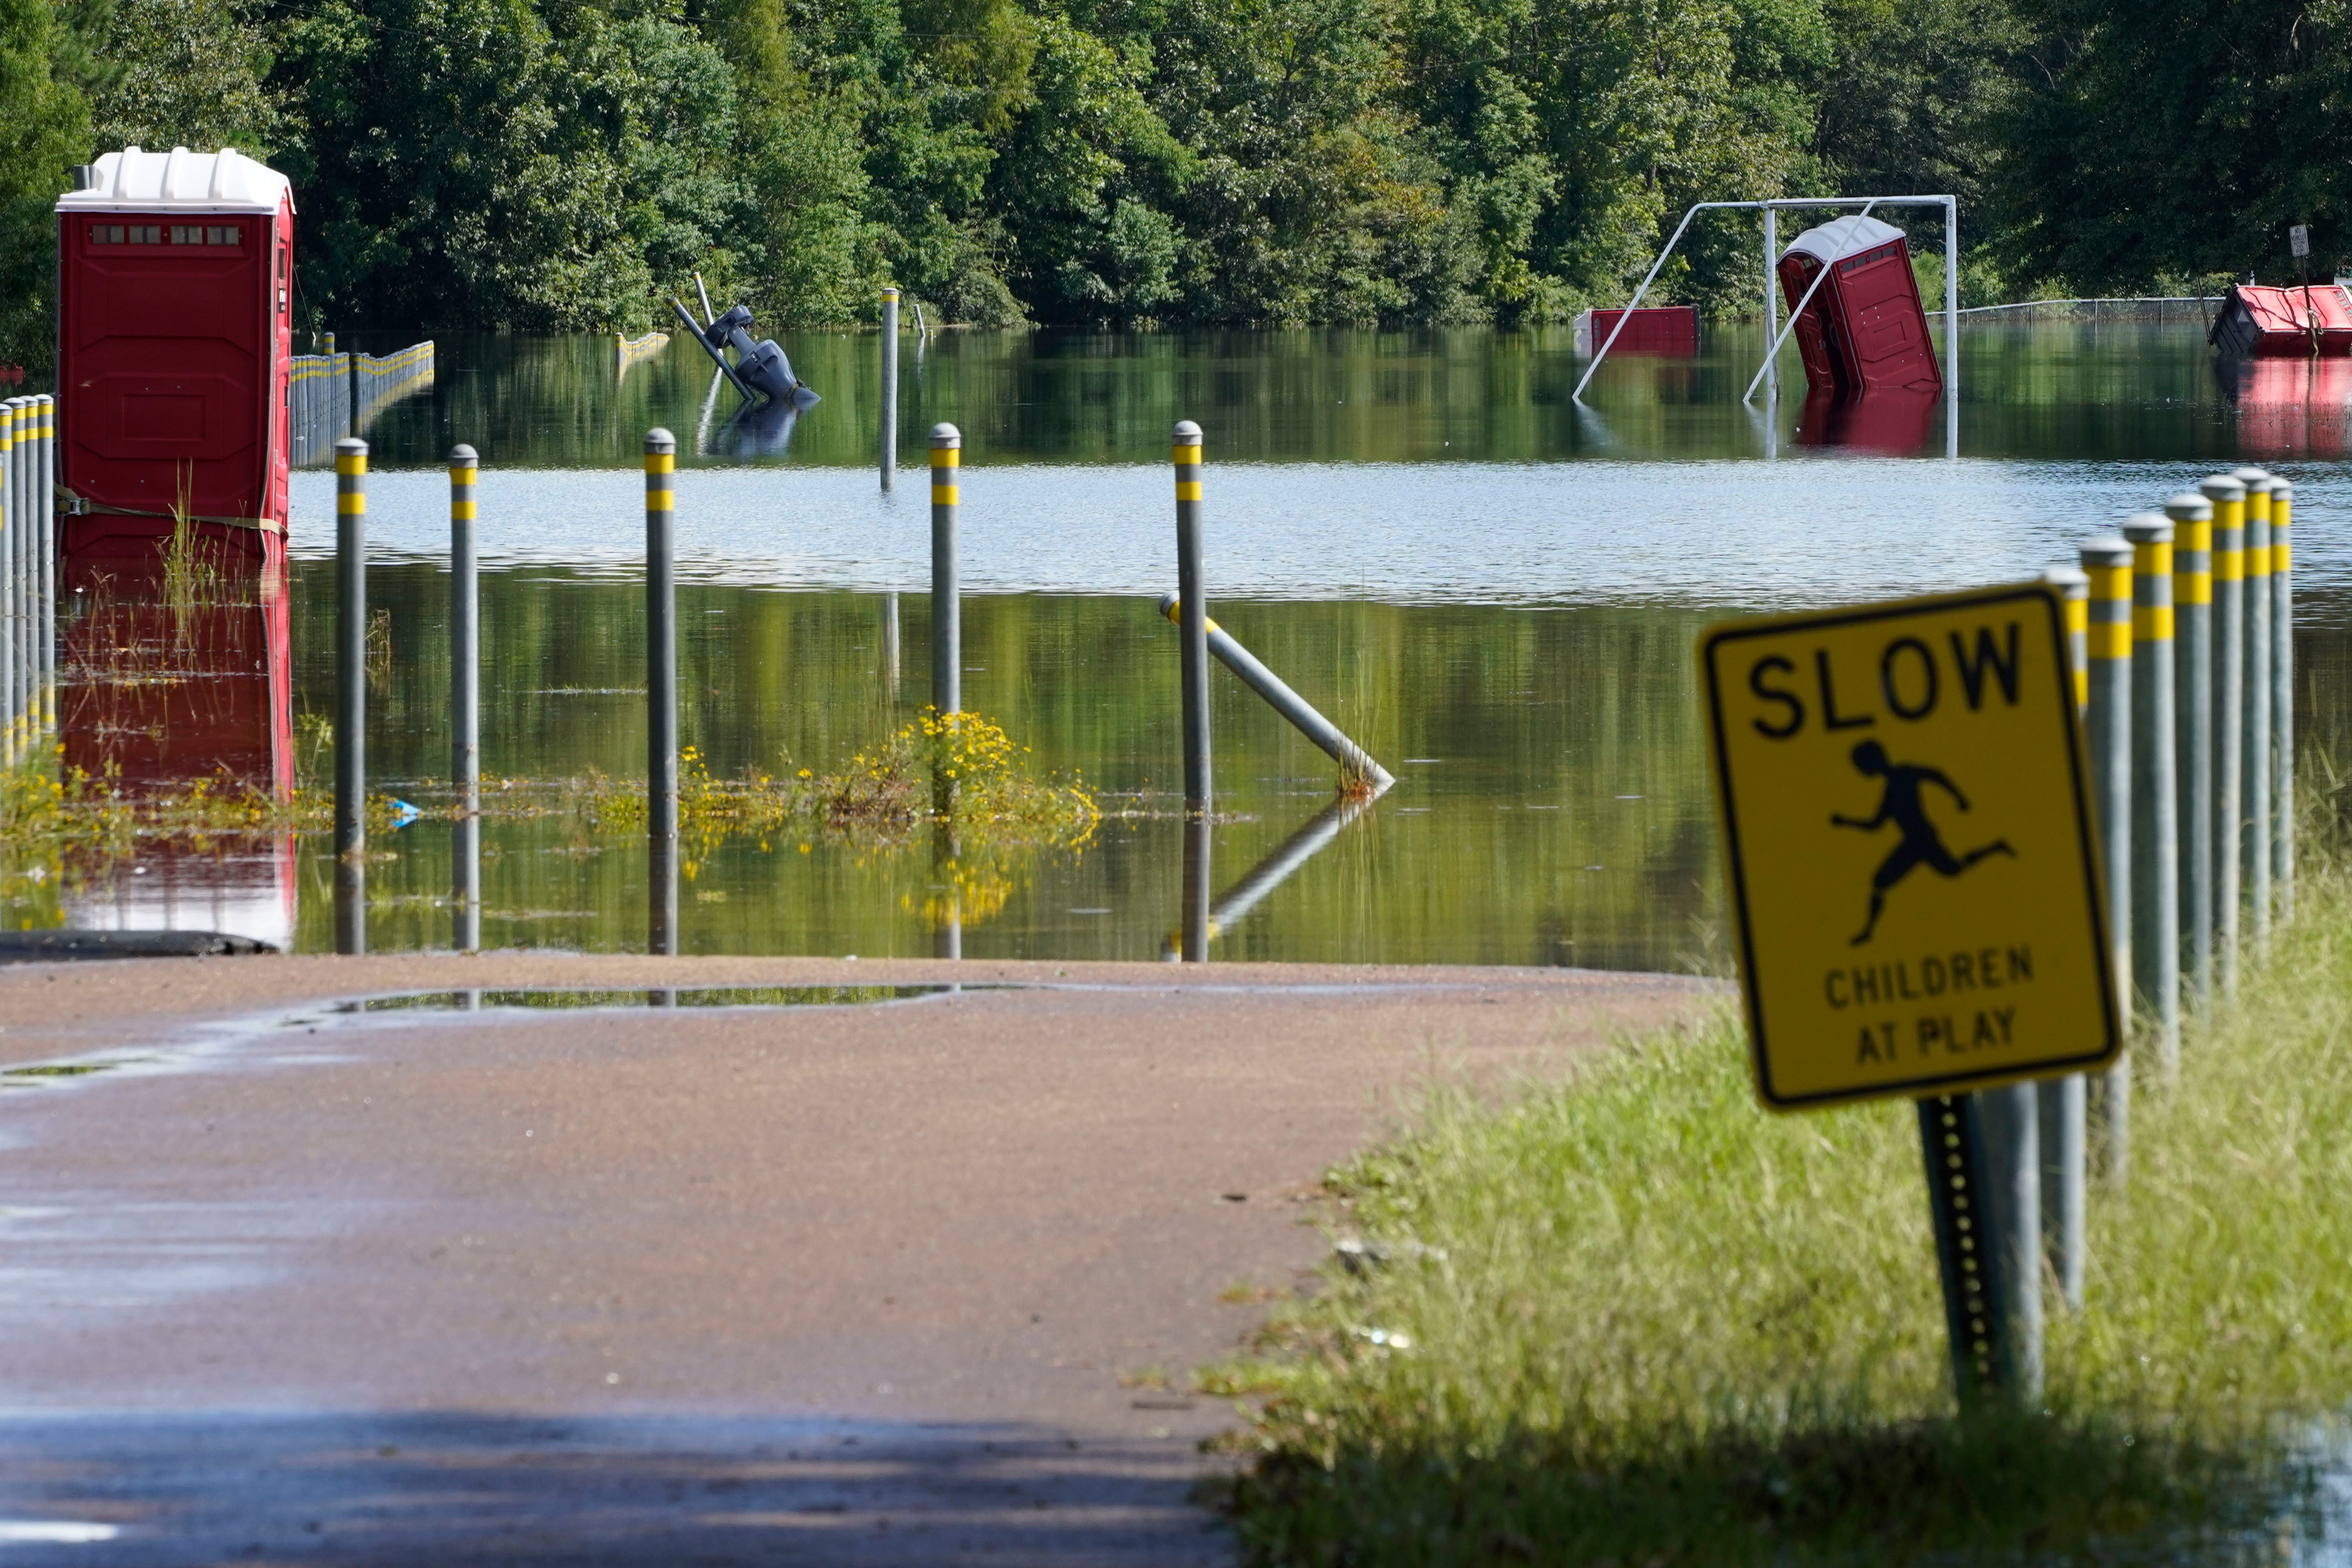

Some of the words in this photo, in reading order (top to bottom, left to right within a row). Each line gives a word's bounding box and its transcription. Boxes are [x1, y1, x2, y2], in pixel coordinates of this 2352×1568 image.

[1748, 621, 2020, 740] SLOW
[1824, 944, 2034, 1009] CHILDREN
[1856, 1022, 1896, 1065] AT
[1917, 1005, 2016, 1055] PLAY
